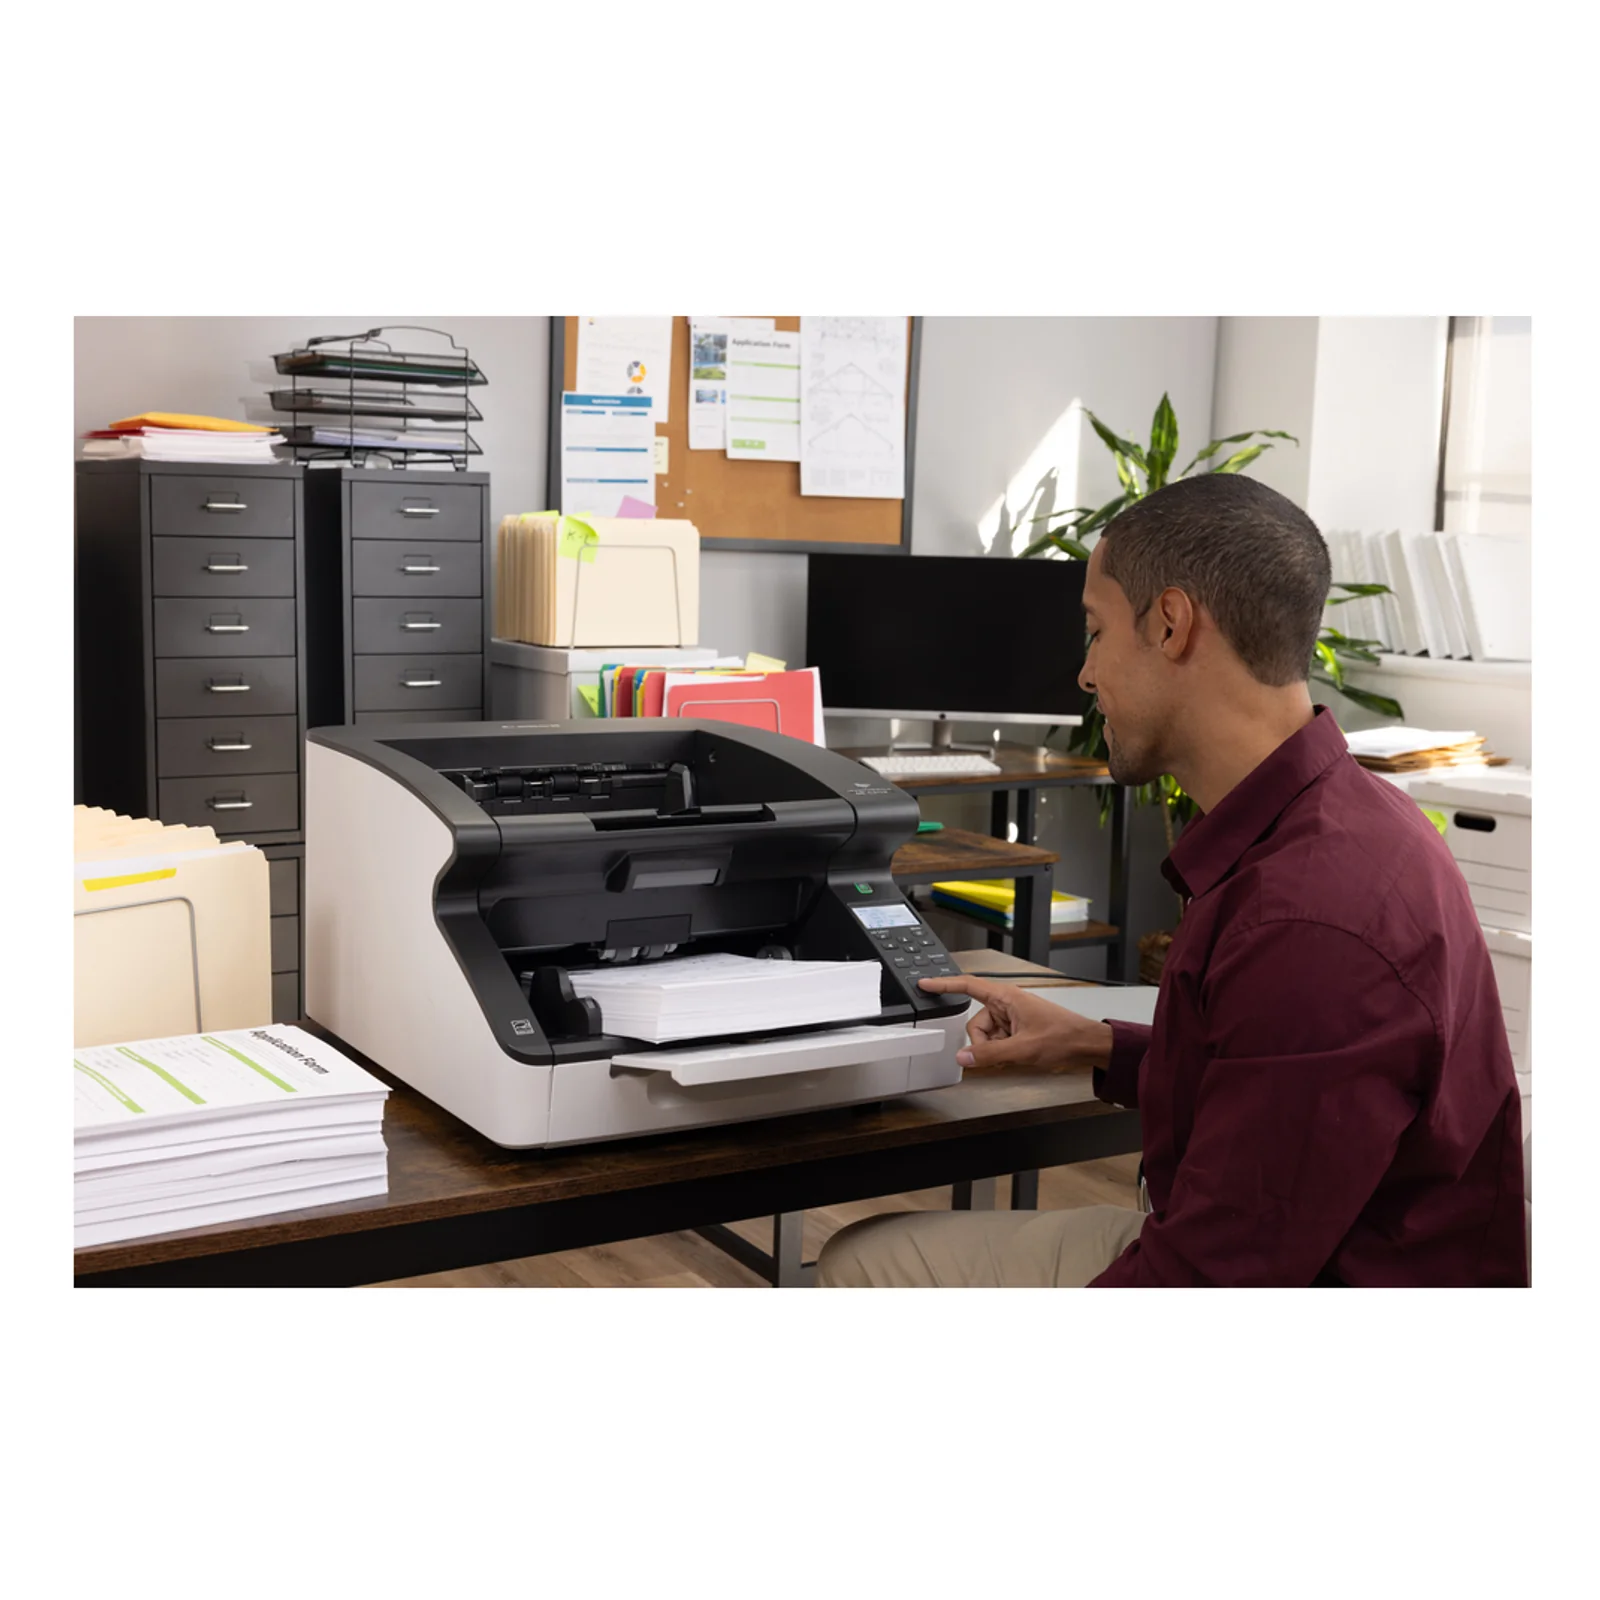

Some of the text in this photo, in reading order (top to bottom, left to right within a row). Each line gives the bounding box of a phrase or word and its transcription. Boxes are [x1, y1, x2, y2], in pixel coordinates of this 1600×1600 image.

[732, 338, 791, 349] Application Form
[249, 1030, 330, 1075] Application Form
